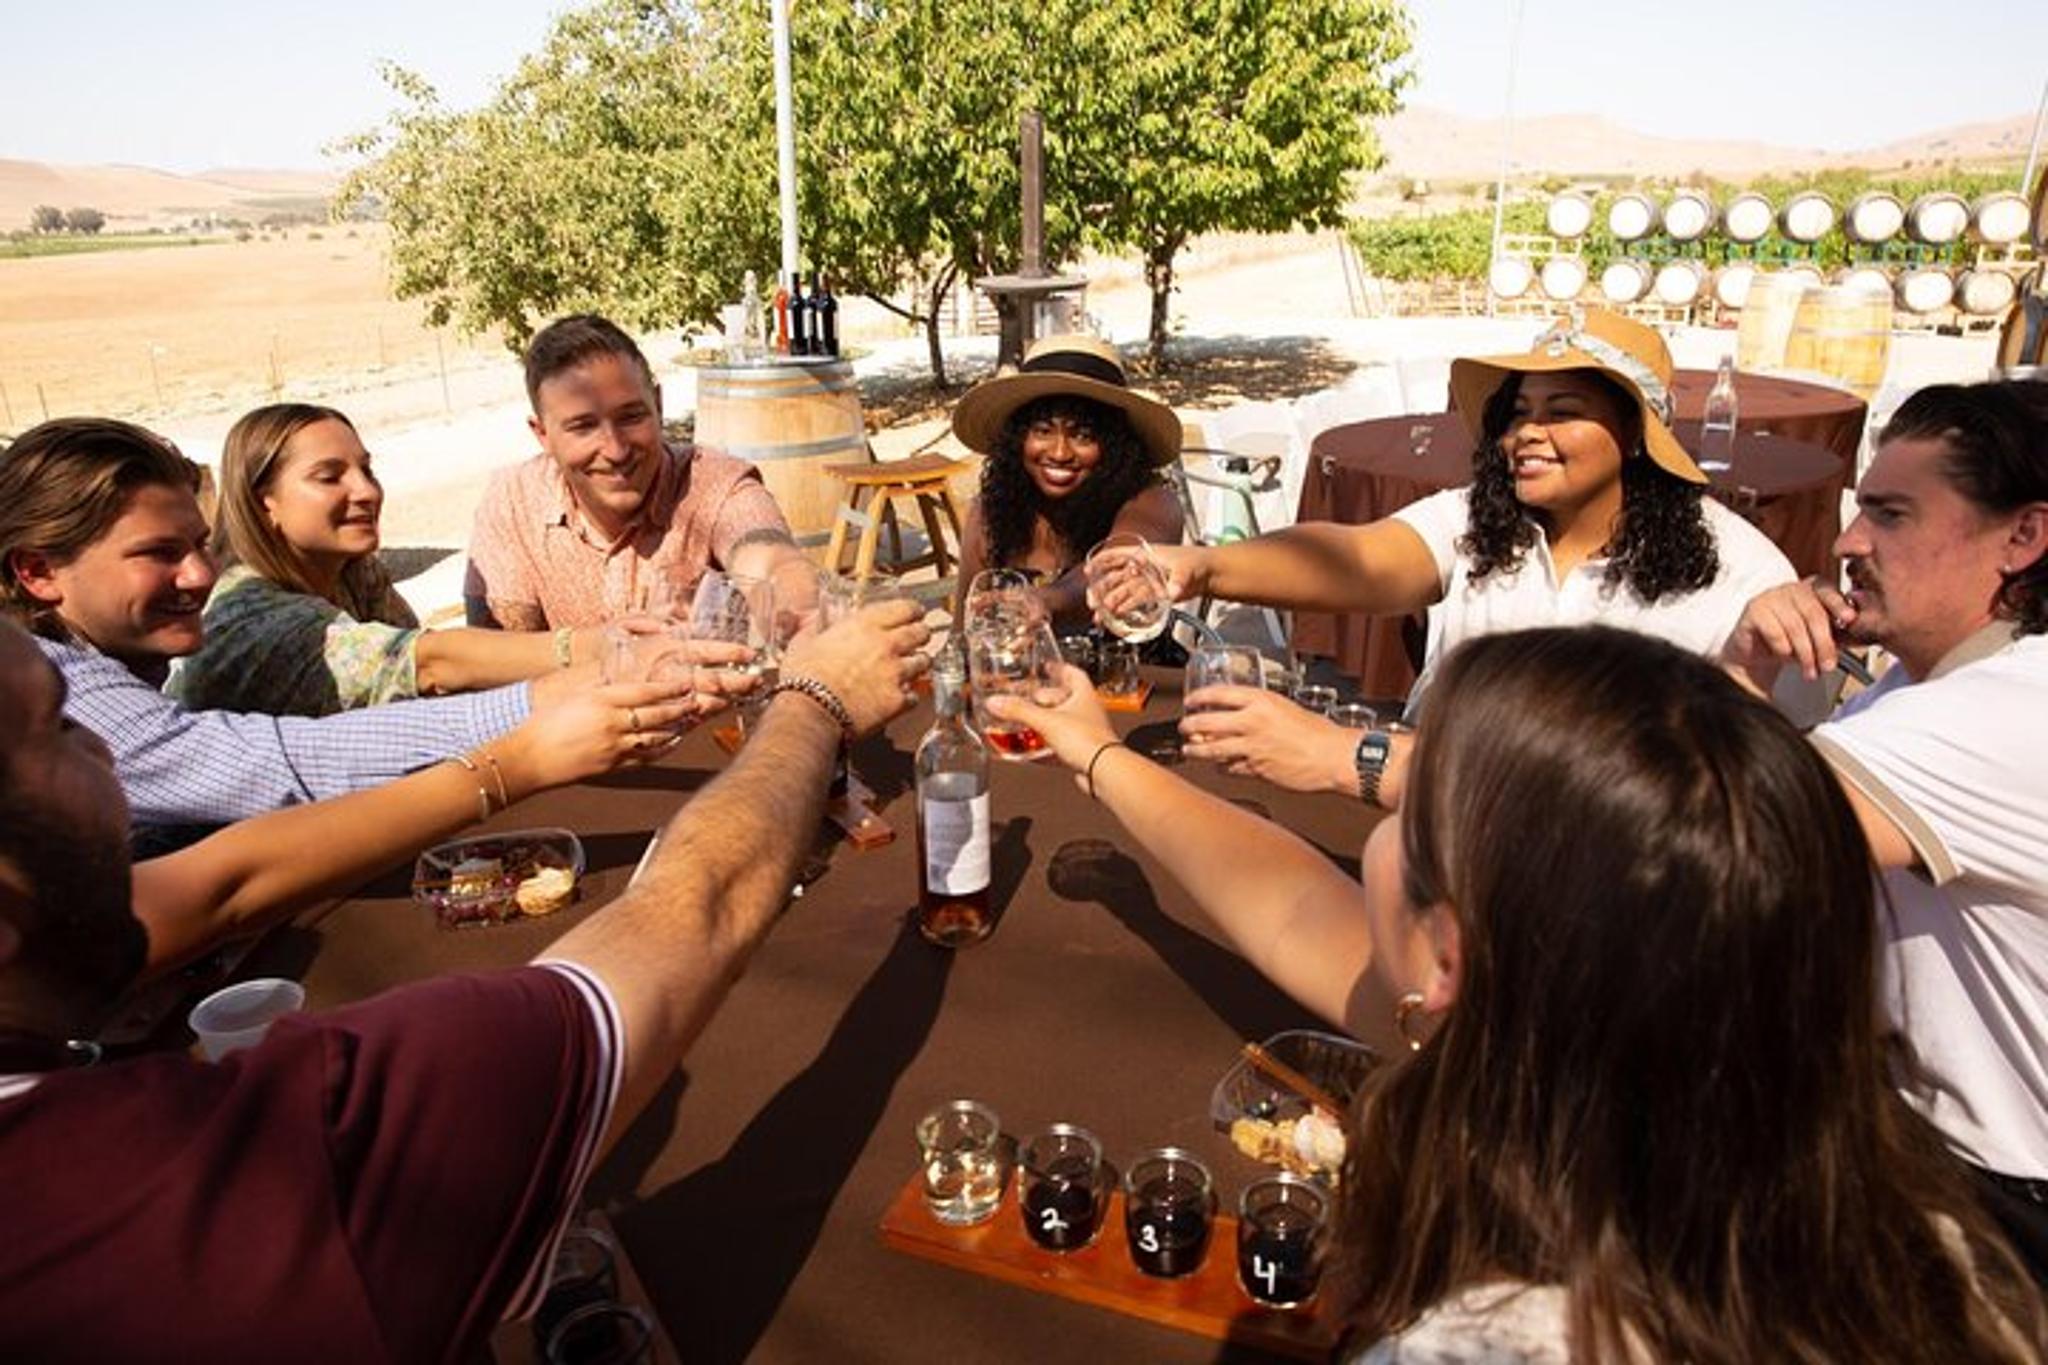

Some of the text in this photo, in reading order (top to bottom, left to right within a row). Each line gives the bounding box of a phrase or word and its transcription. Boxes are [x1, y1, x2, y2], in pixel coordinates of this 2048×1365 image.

[1040, 1207, 1069, 1230] 2
[1138, 1224, 1159, 1252] 3
[1253, 1254, 1275, 1295] 4
